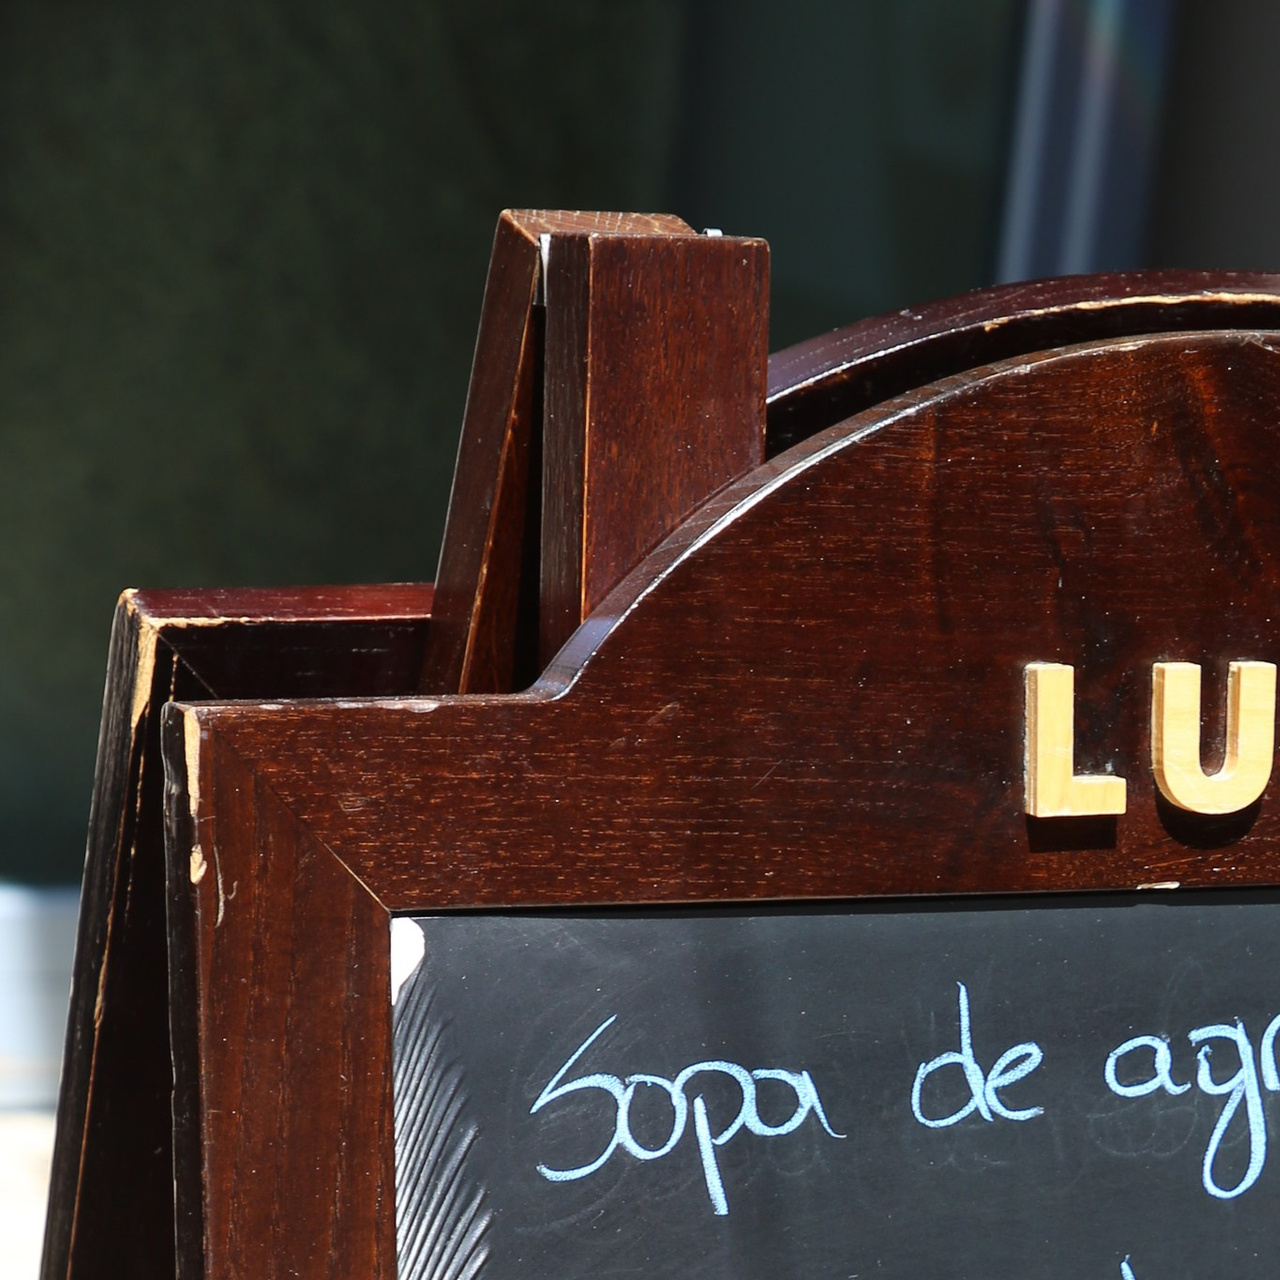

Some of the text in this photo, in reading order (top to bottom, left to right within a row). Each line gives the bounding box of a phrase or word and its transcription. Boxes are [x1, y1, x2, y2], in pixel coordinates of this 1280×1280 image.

[1023, 661, 1278, 817] LU
[530, 1015, 846, 1215] Sopa
[912, 980, 1044, 1128] de
